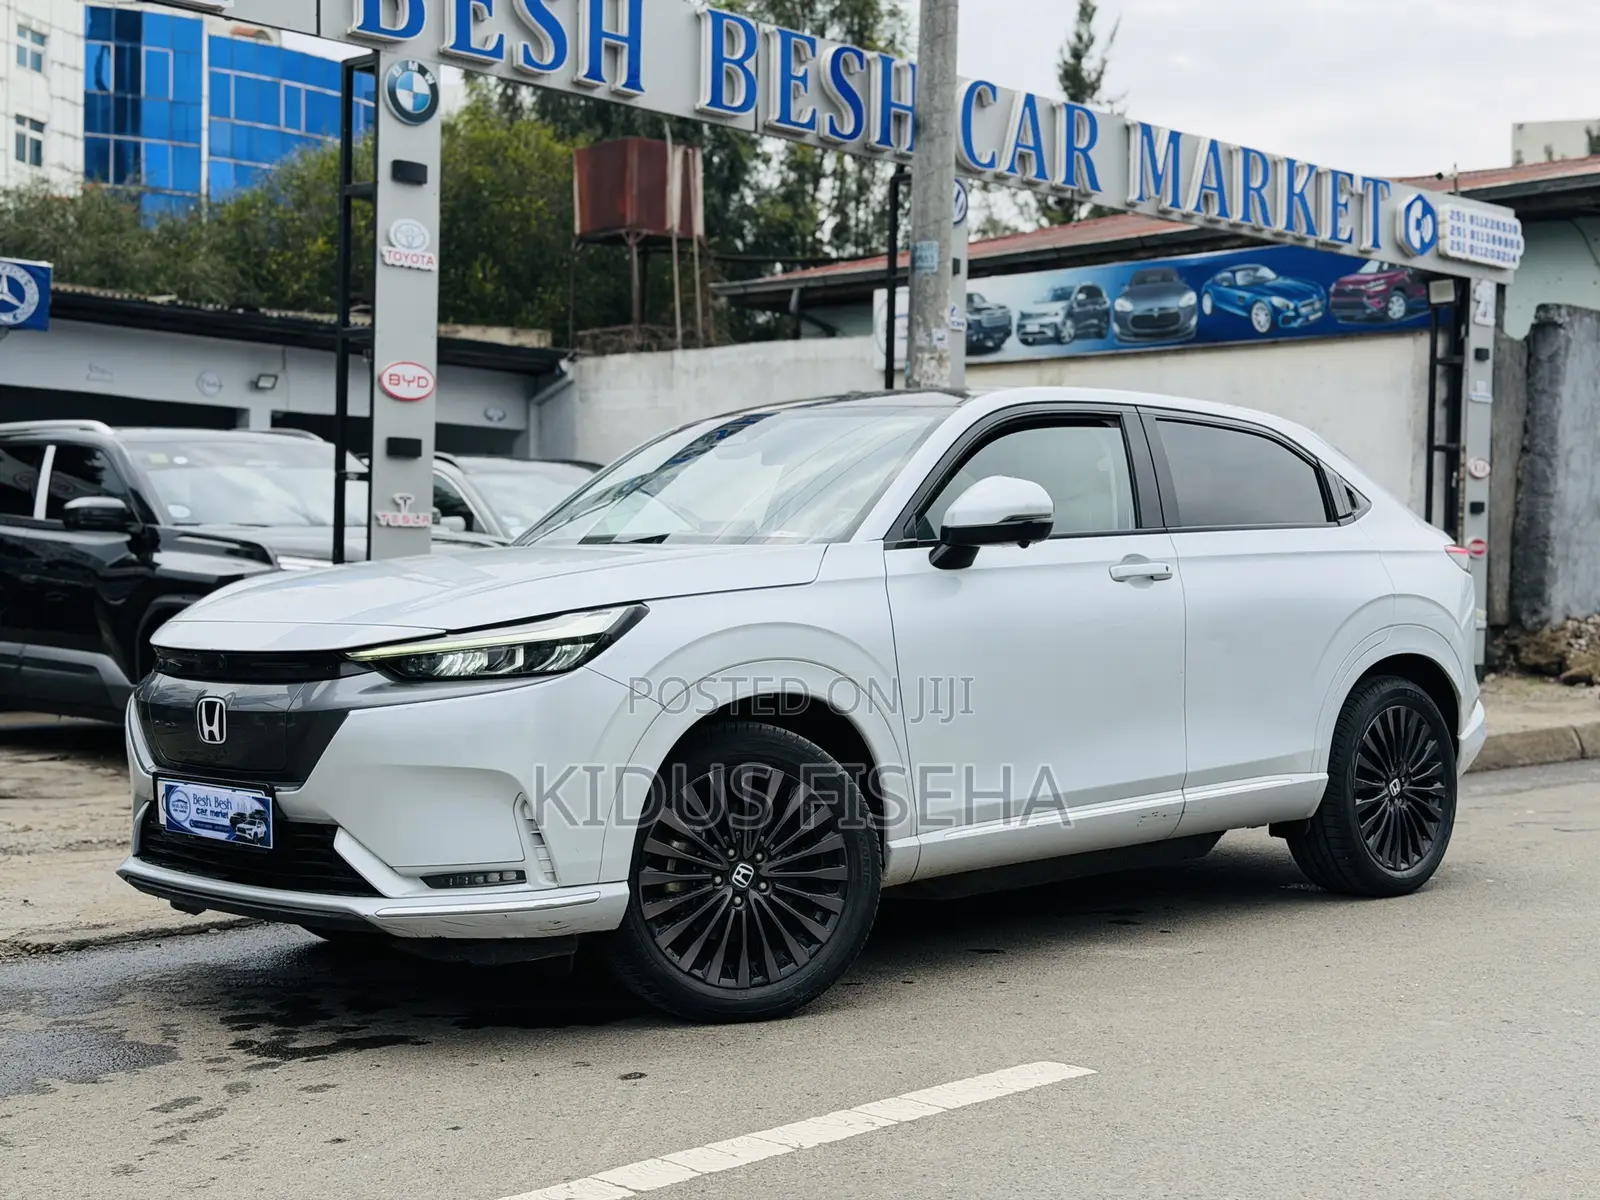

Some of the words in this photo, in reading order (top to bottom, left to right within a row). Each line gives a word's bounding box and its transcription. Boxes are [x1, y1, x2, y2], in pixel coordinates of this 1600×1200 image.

[702, 8, 917, 154] BESH
[959, 79, 1103, 193] CAR
[1134, 120, 1392, 252] MARKET
[386, 249, 434, 266] TOYOTA
[388, 373, 430, 389] BYD
[192, 793, 212, 807] Besh
[214, 796, 233, 811] Besh
[195, 807, 208, 816] car
